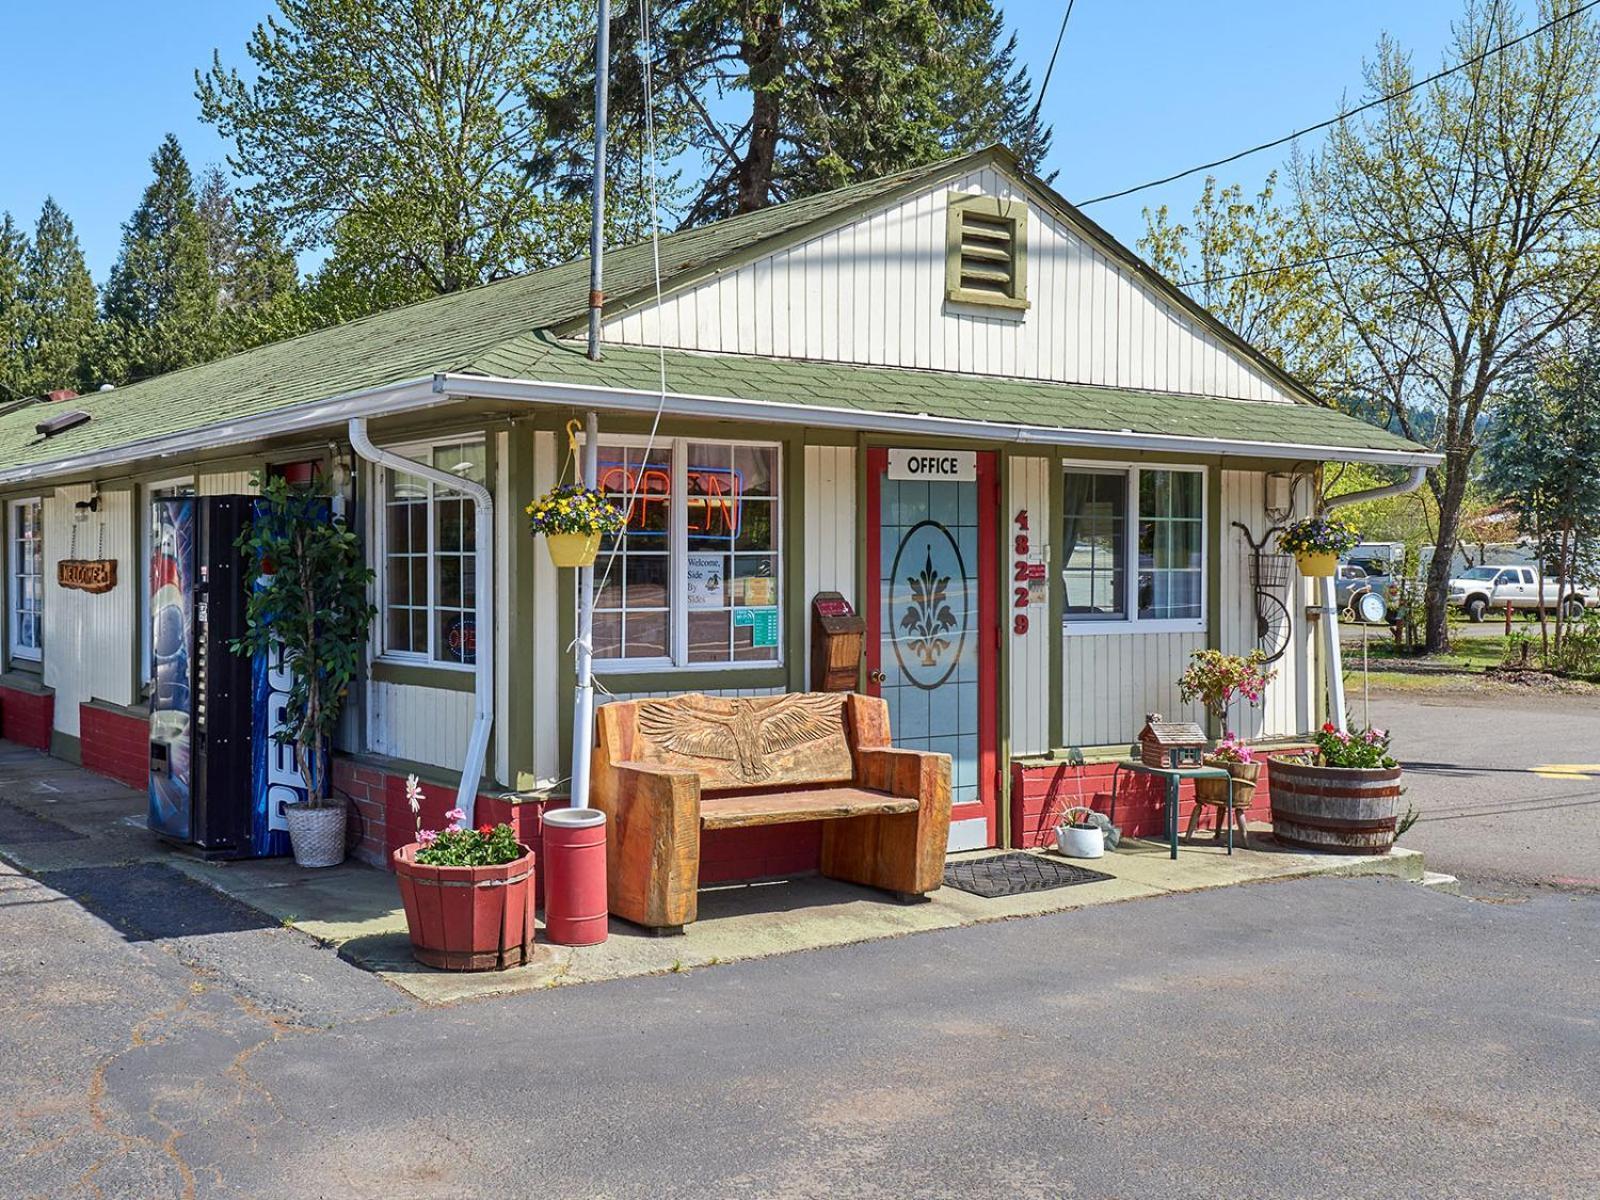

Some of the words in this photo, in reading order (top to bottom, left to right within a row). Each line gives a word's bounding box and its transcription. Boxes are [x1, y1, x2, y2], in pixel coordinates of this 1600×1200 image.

[908, 456, 958, 475] OFFICE
[687, 570, 704, 580] Side
[1014, 510, 1029, 635] 48229
